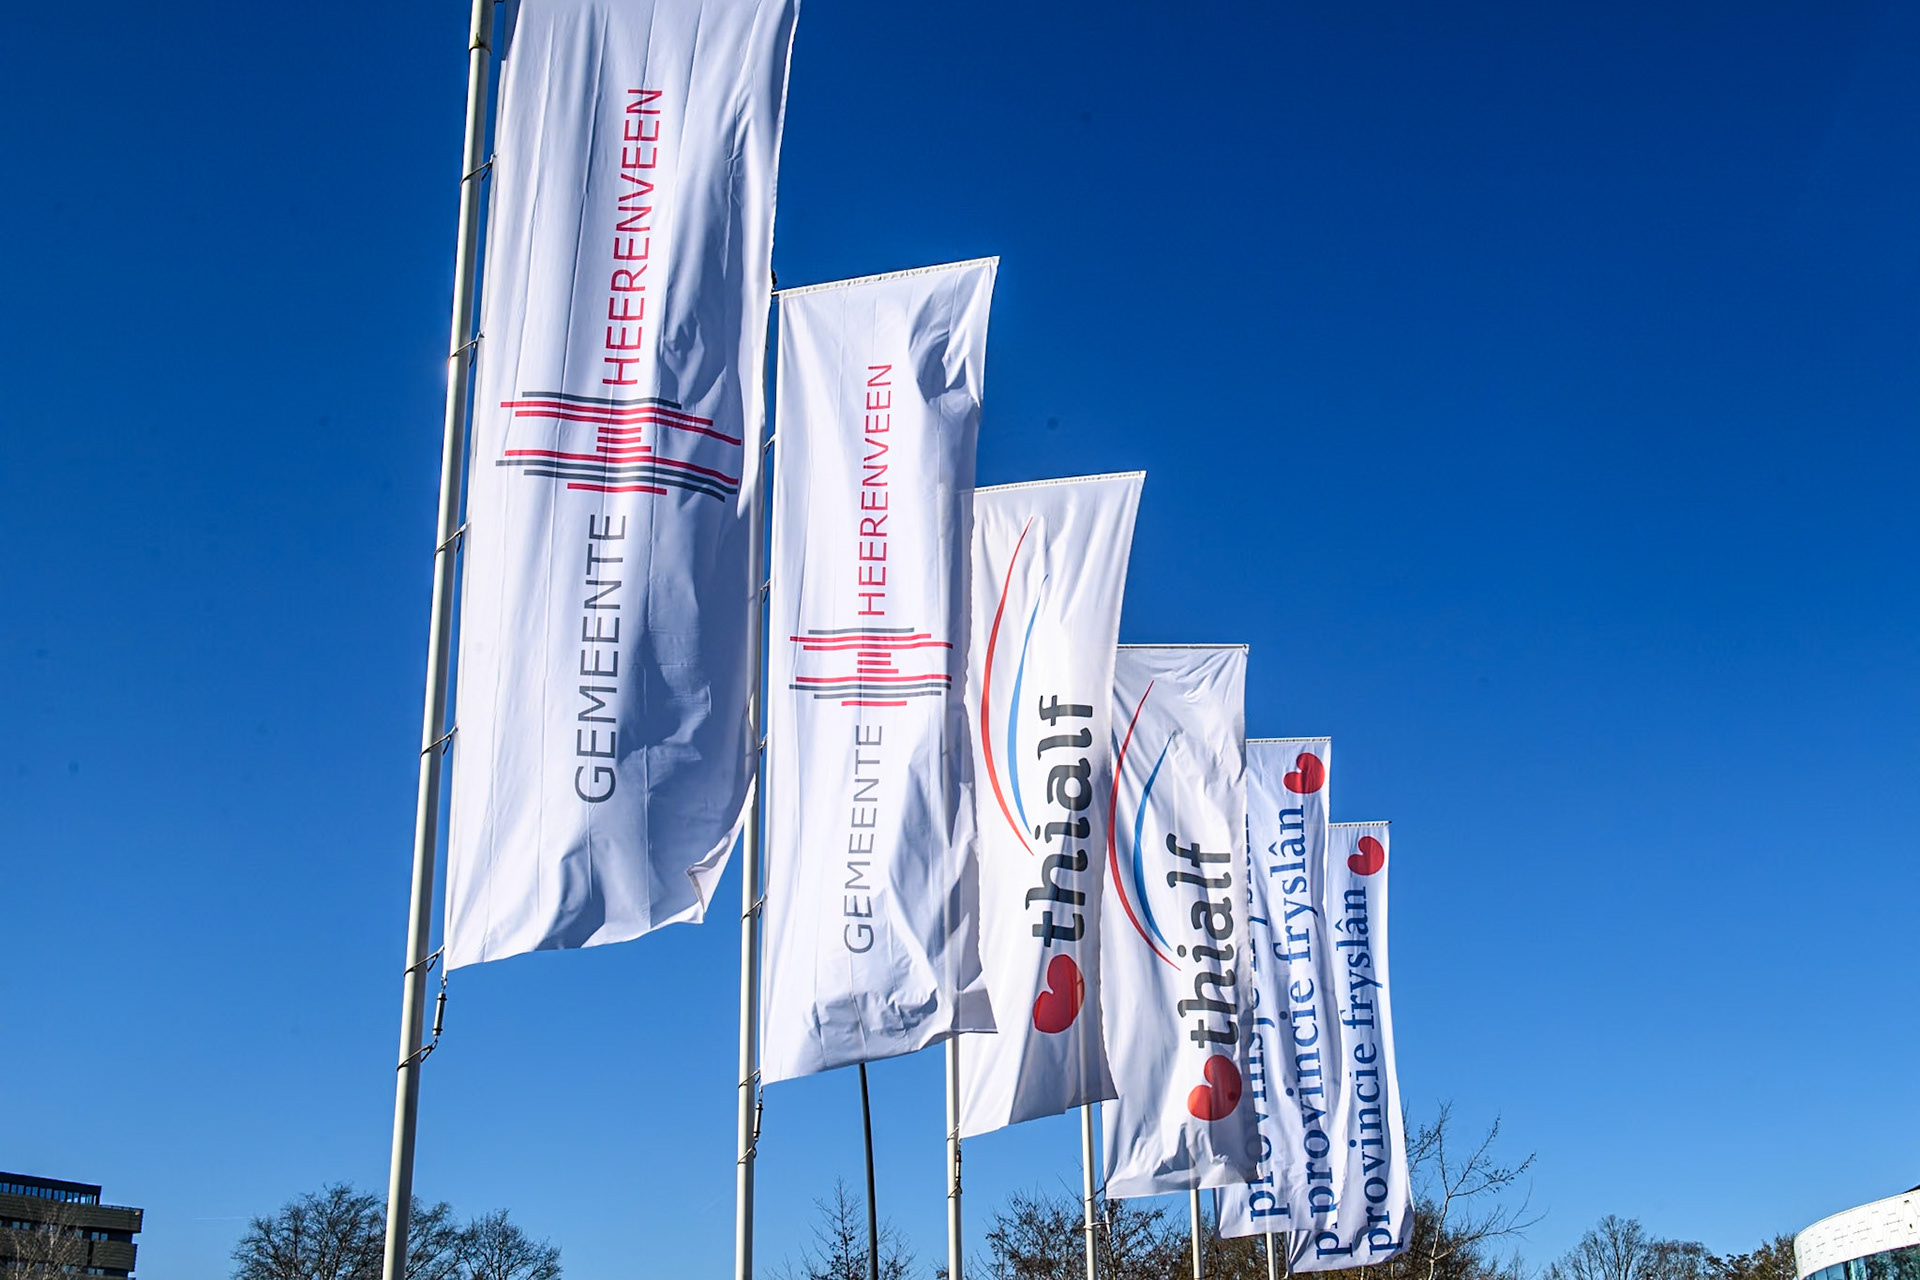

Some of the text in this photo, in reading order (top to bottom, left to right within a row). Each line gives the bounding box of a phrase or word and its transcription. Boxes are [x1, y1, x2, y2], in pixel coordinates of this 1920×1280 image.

[574, 89, 663, 804] GEMEENTE HEERENVEEN
[844, 364, 892, 954] GEMEENTE HEERENVEEN
[1026, 695, 1093, 947] thialf
[1167, 834, 1238, 1048] thialf
[1268, 804, 1318, 962] fryslân
[1280, 978, 1337, 1218] provincie
[1335, 886, 1404, 1256] provincie fryslân
